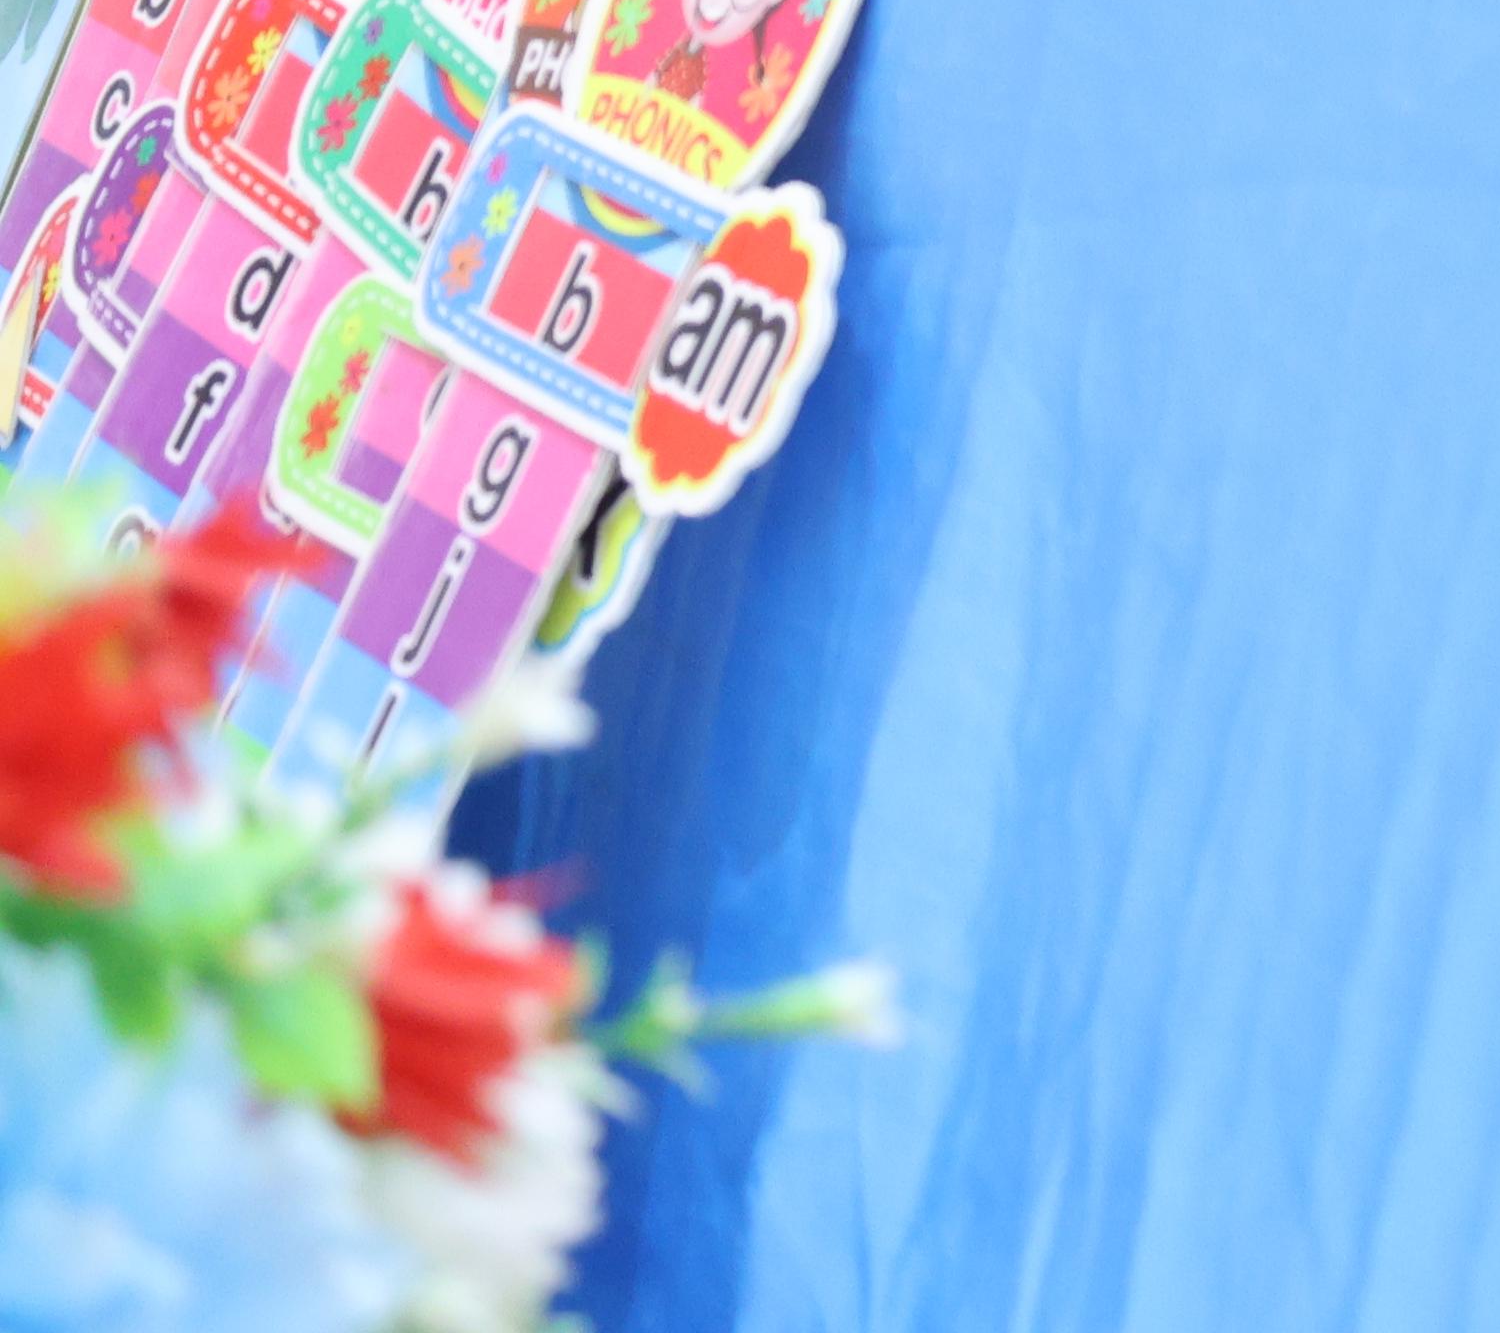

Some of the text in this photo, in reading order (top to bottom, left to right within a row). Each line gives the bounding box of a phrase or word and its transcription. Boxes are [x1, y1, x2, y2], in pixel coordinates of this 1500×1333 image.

[94, 77, 132, 141] c
[590, 90, 724, 182] PHONICS
[543, 253, 593, 354] b
[660, 277, 787, 421] am
[174, 369, 226, 452] f
[467, 426, 531, 524] g
[401, 546, 464, 664] j
